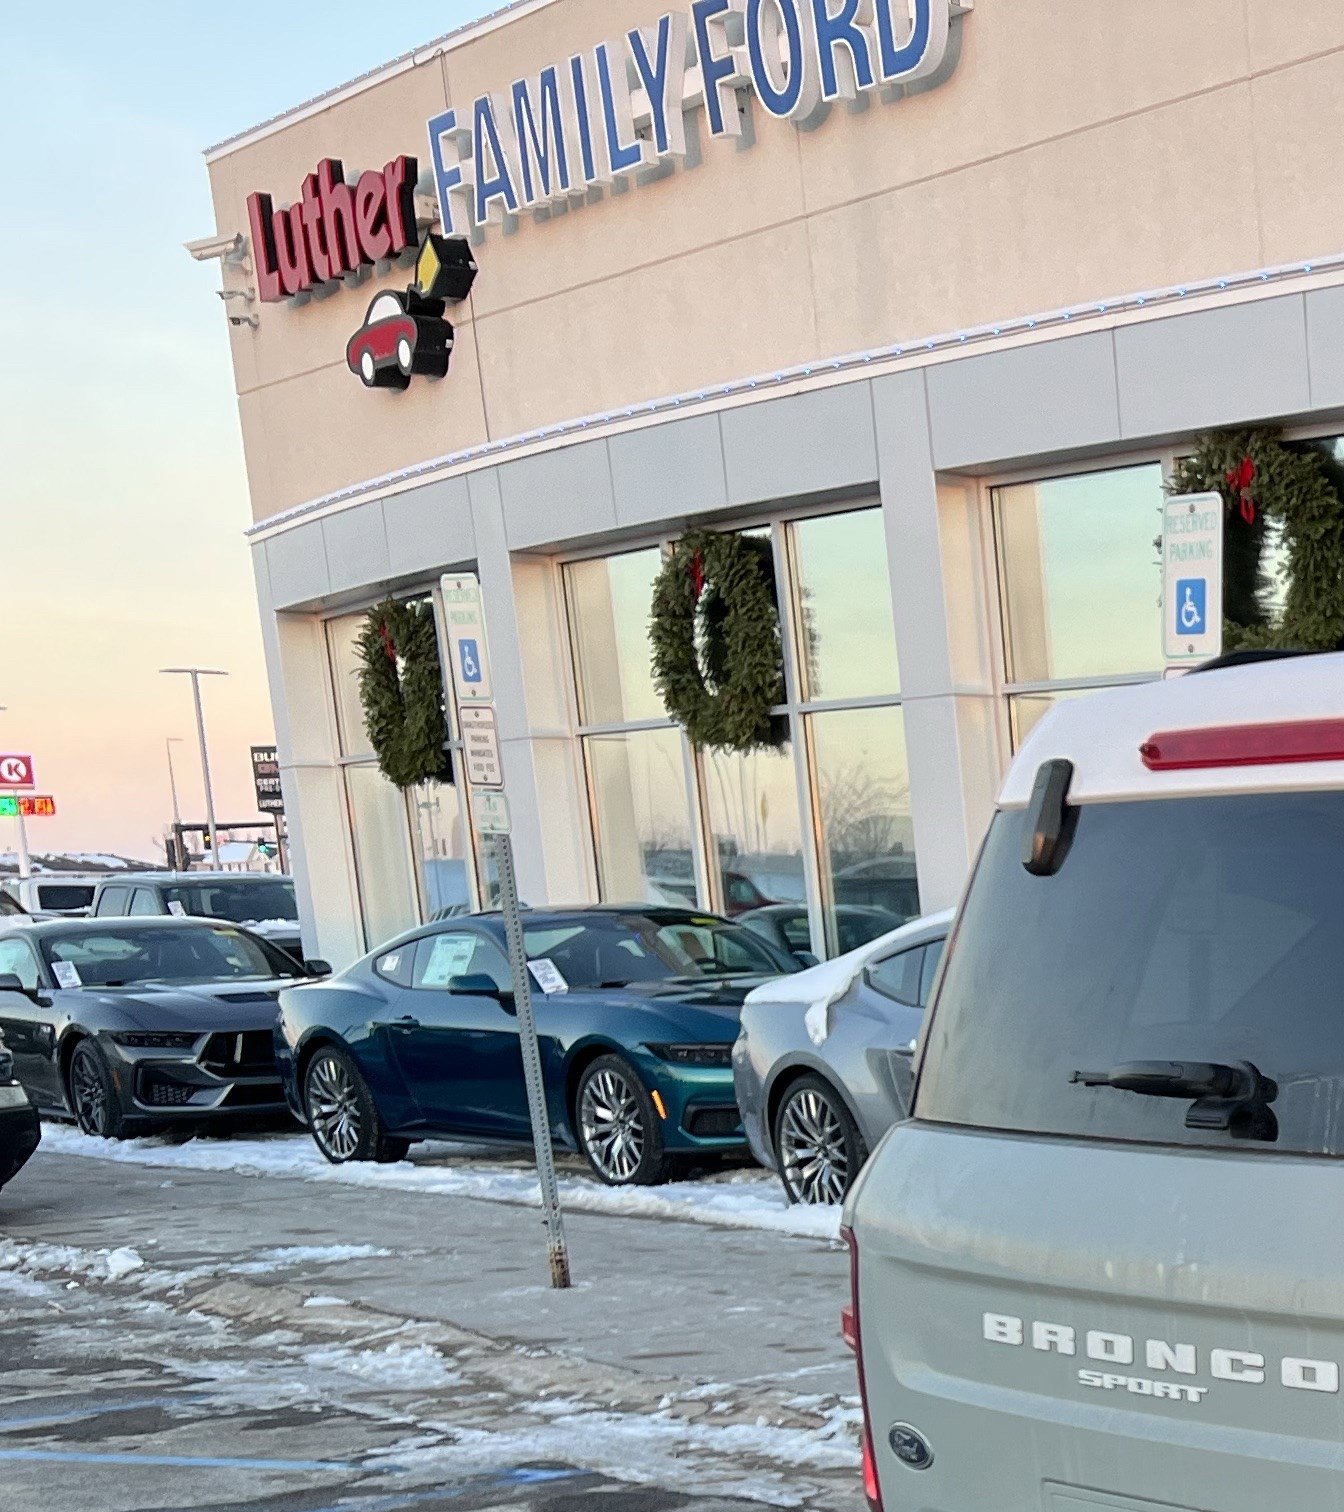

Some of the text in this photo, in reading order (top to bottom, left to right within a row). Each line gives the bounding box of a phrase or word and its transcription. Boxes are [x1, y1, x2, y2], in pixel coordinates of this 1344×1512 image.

[426, 0, 942, 238] FAMILY FORD
[247, 154, 416, 302] Luther
[1170, 540, 1212, 561] PARKING
[7, 762, 24, 778] K
[982, 1311, 1340, 1394] BRONCO
[1077, 1368, 1208, 1403] SPORT
